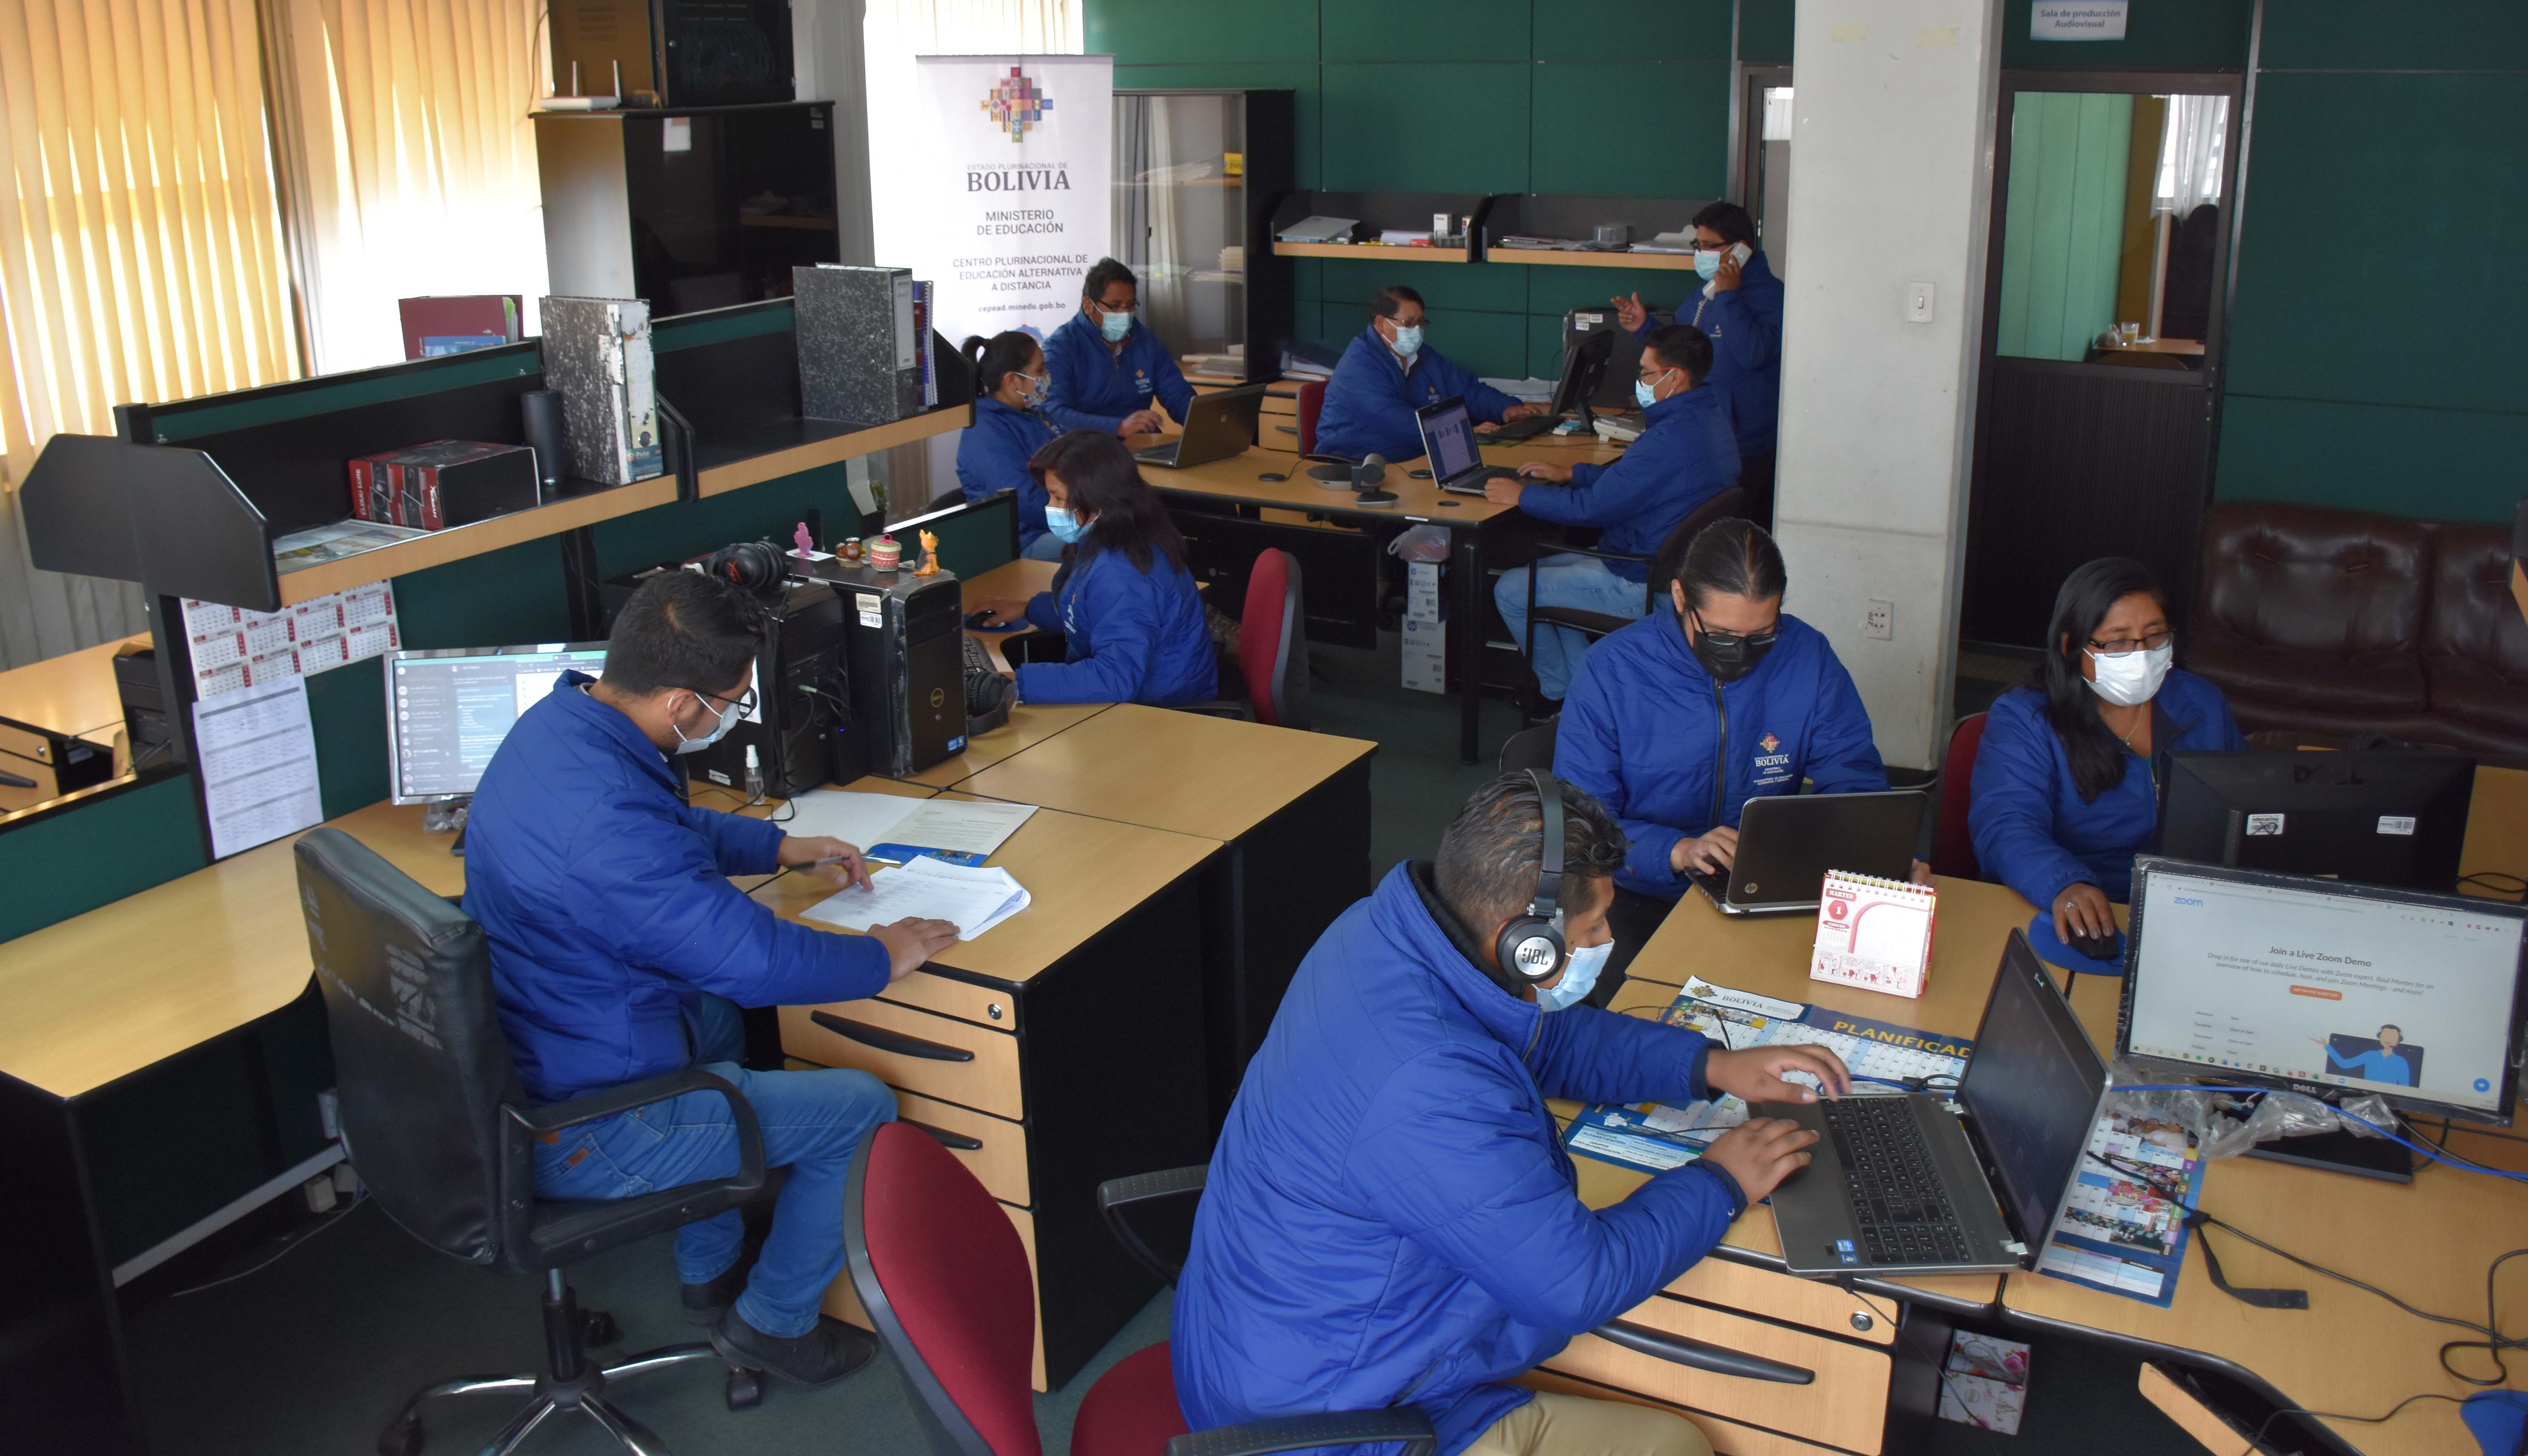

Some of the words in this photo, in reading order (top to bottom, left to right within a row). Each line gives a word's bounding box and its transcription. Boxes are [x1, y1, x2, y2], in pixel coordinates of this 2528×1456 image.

[2073, 10, 2120, 19] producción
[967, 170, 1071, 192] BOLIVIA
[986, 210, 1054, 221] MINISTERIO
[977, 225, 992, 235] DE
[996, 221, 1064, 235] EDUCACIÓN
[953, 257, 992, 268] CENTRO
[995, 255, 1072, 266] PLURINACIONAL
[1075, 254, 1088, 264] DE
[959, 268, 1015, 280] EDUCACIÓN
[1018, 267, 1083, 277] ALTERNATIVA
[991, 283, 998, 291] A
[1001, 281, 1051, 291] DISTANCIA
[978, 302, 1066, 312] cepead.minedu.gob.bo
[1755, 757, 1790, 767] BOLIVIA
[1829, 890, 1853, 899] MARTES
[2174, 896, 2203, 907] zoom
[1836, 906, 1842, 915] 1
[1521, 948, 1548, 965] JBL
[2269, 946, 2287, 956] Join
[2297, 950, 2315, 959] Live
[2316, 953, 2342, 963] Zoom
[2345, 956, 2371, 967] Demo
[2216, 962, 2241, 970] overview
[2271, 970, 2298, 978] schedule,
[2328, 977, 2339, 985] join
[2340, 979, 2358, 987] Zoom
[2359, 981, 2387, 991] Meetings
[2392, 986, 2404, 994] and
[2299, 965, 2319, 974] Demos
[2391, 978, 2414, 987] Montes
[2415, 981, 2425, 989] for
[1721, 996, 1764, 1008] BOLIVIA
[2292, 1083, 2317, 1093] DELL
[1583, 1132, 1626, 1145] ALFABETIZACIÓN
